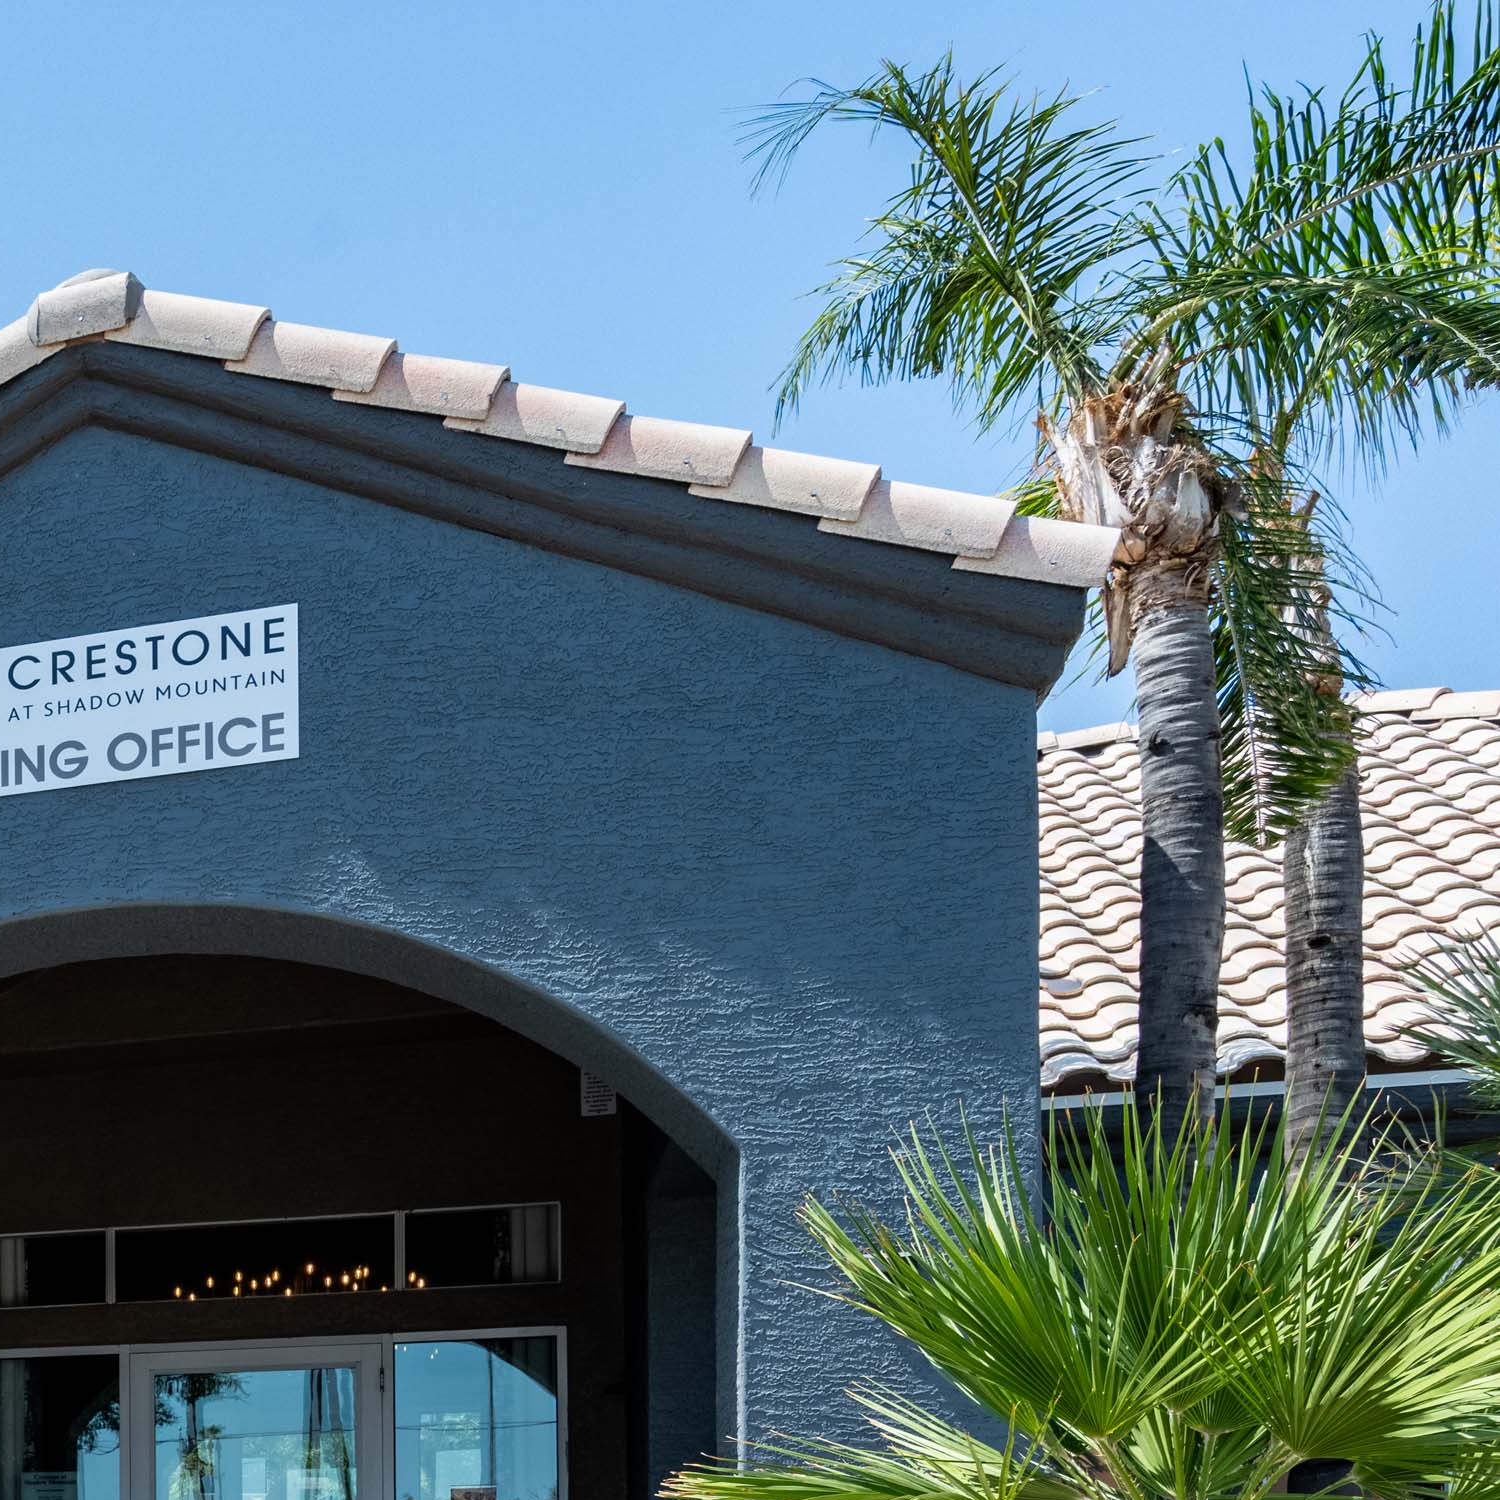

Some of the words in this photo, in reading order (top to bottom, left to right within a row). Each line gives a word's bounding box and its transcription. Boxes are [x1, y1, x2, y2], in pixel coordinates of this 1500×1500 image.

[8, 617, 286, 690] CRESTONE
[8, 704, 34, 722] AT
[43, 689, 145, 716] SHADOW
[155, 669, 286, 701] MOUNTAIN
[106, 711, 286, 771] OFFICE
